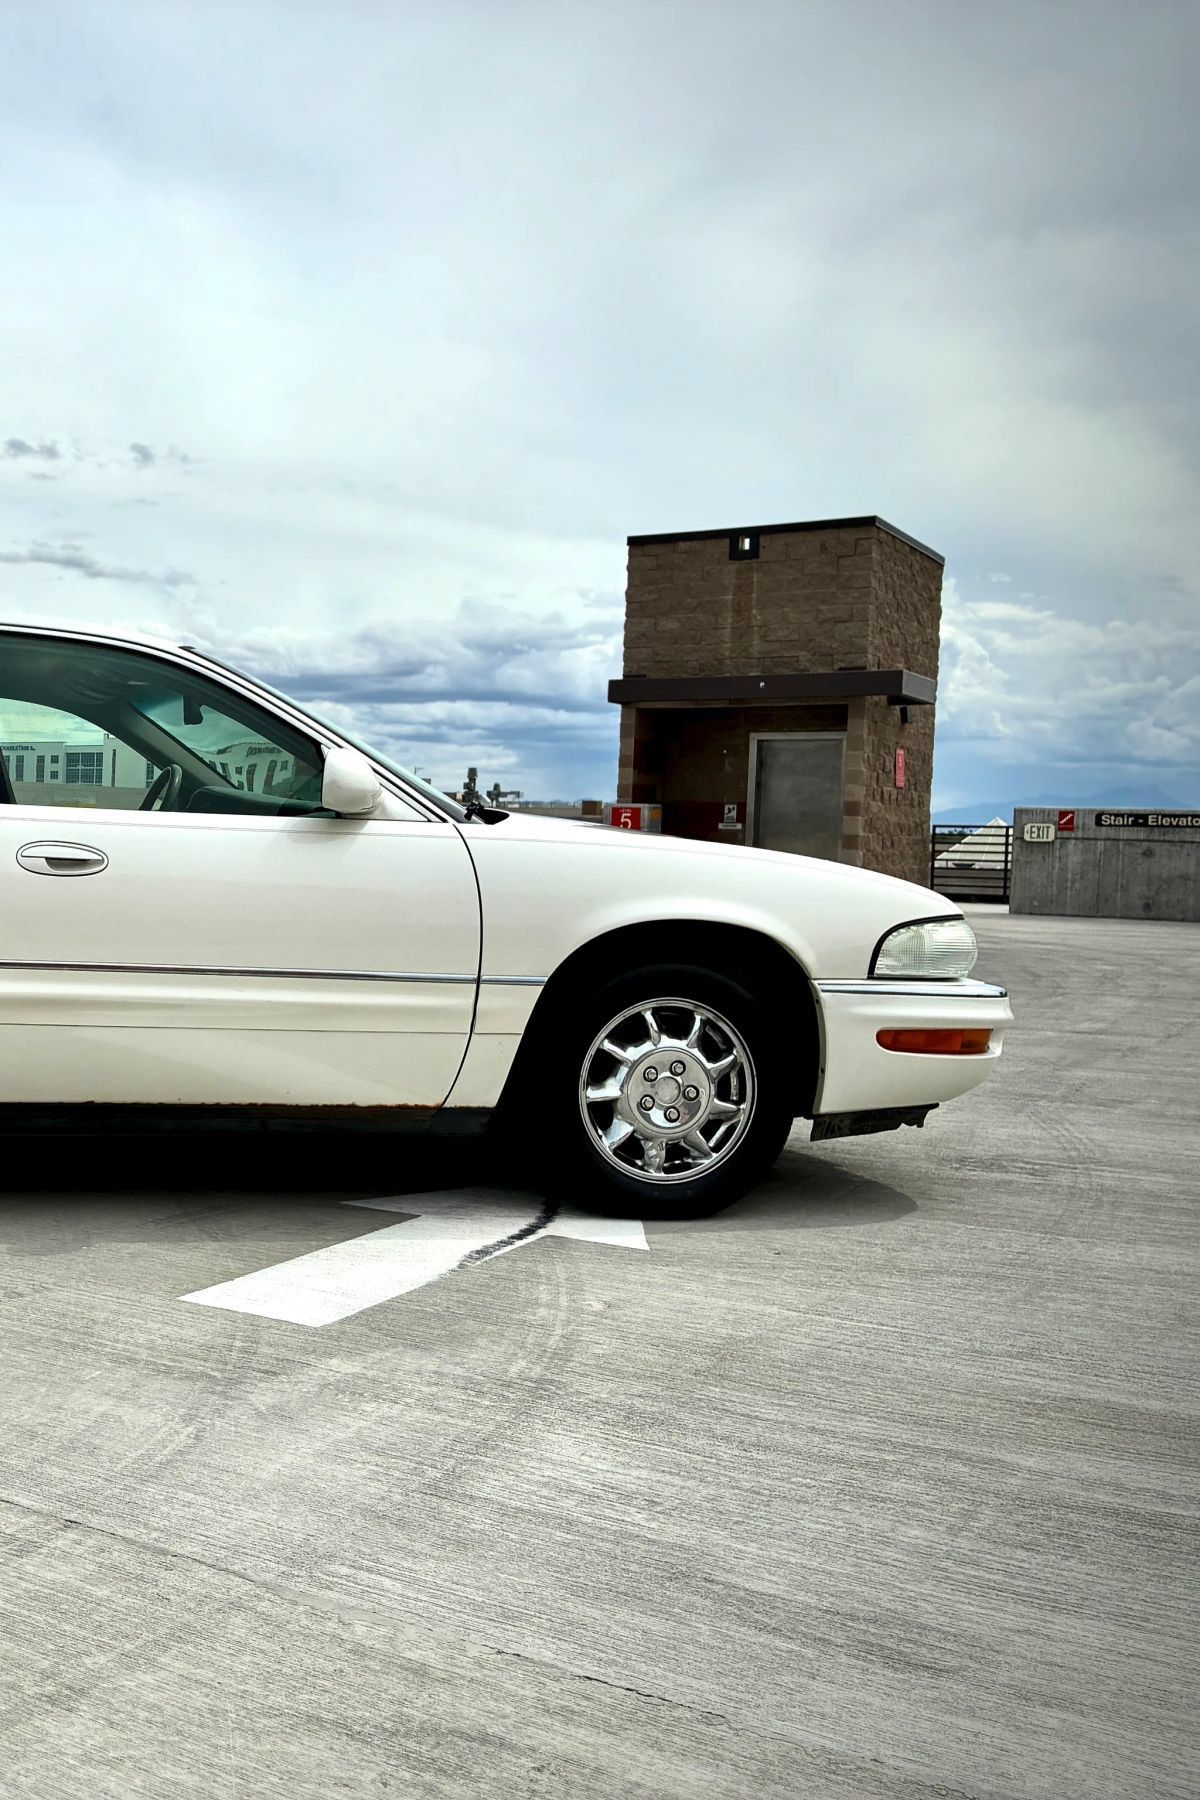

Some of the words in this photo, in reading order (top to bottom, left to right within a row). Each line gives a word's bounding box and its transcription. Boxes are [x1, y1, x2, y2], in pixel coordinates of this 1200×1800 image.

[620, 813, 632, 829] 5
[1101, 814, 1135, 826] Stair
[1147, 815, 1200, 827] Elevato
[1029, 824, 1051, 840] EXIT
